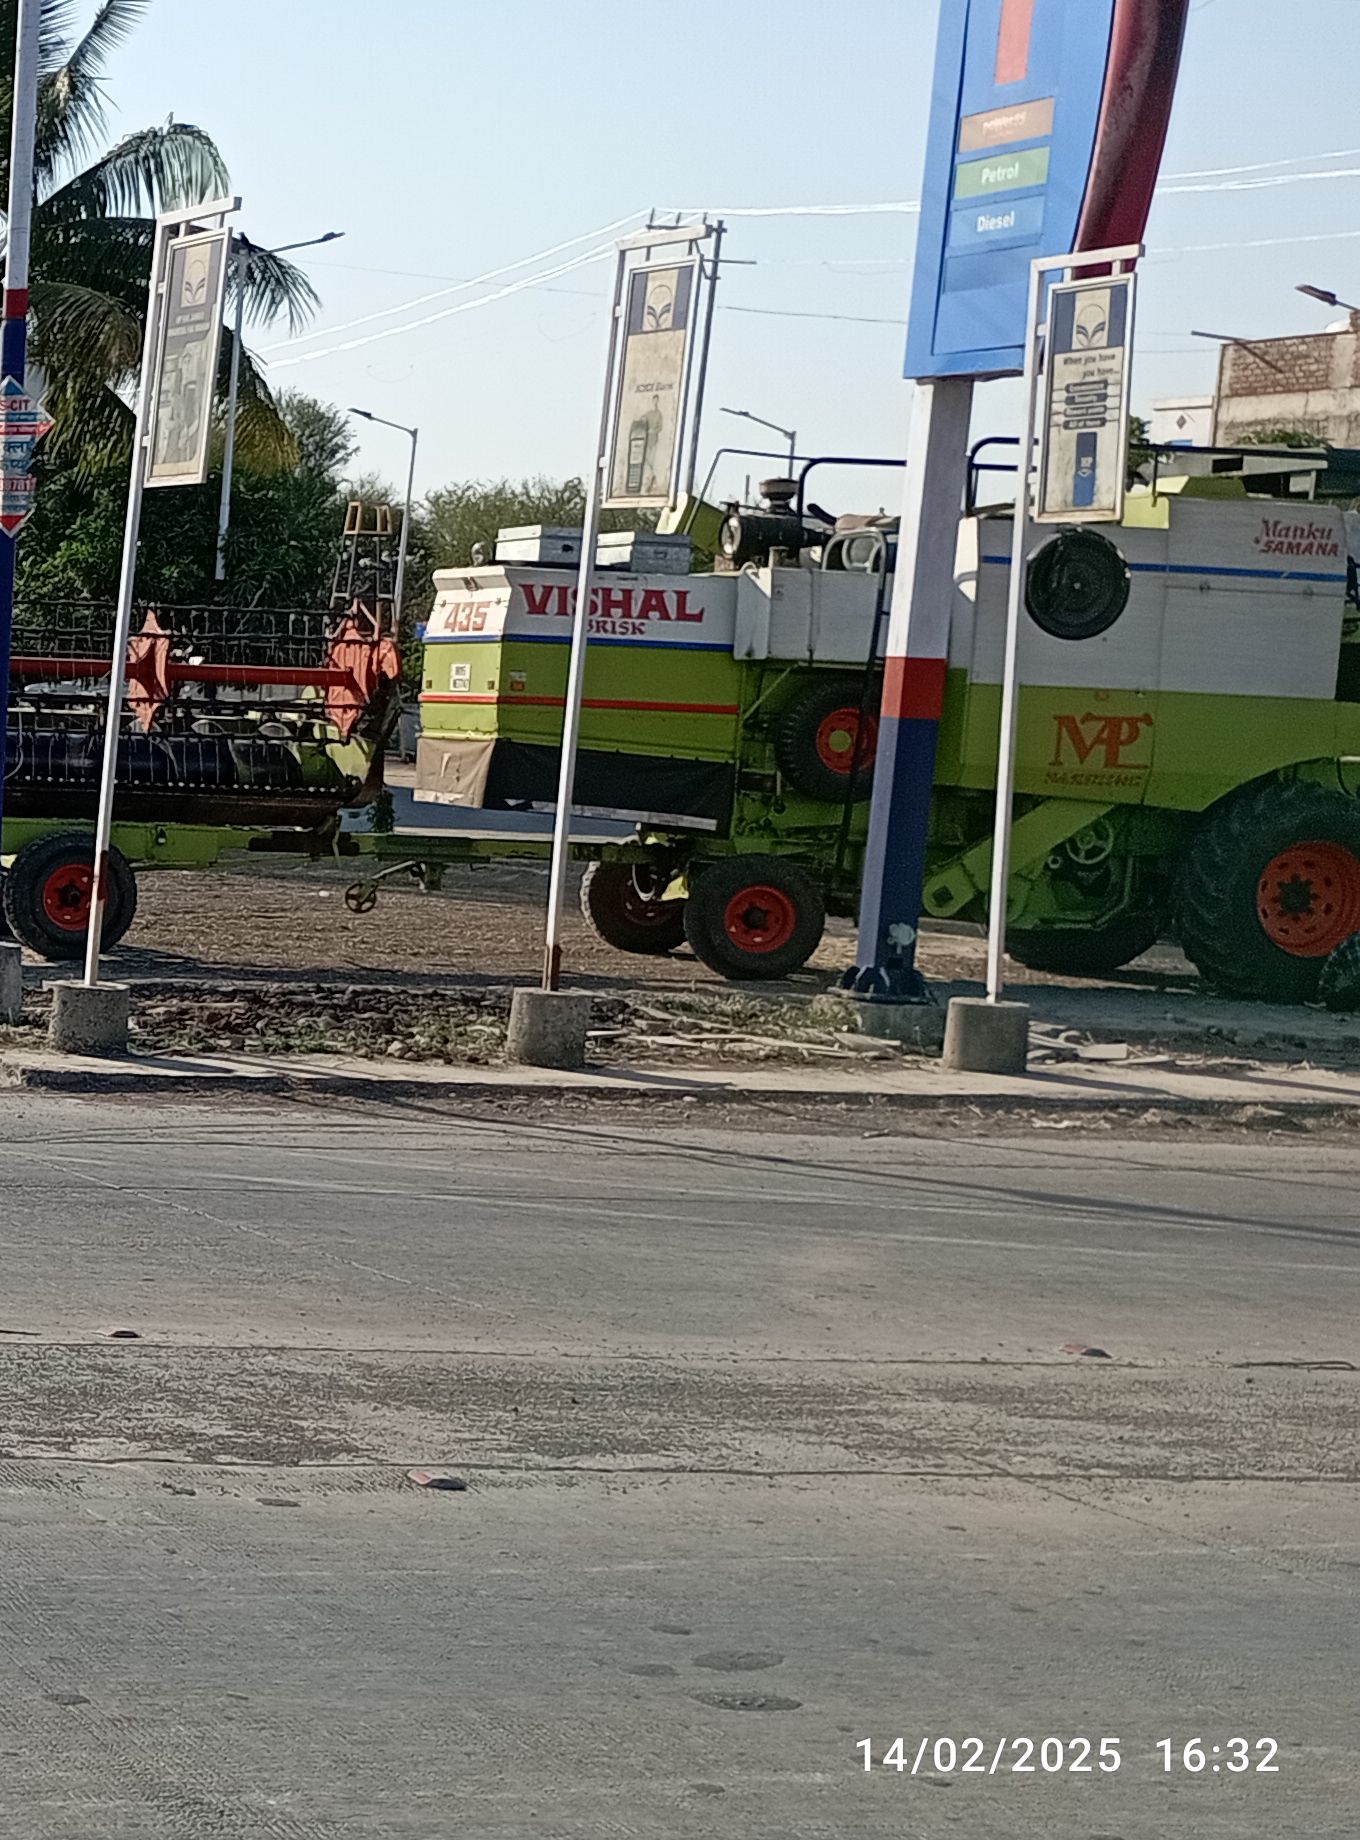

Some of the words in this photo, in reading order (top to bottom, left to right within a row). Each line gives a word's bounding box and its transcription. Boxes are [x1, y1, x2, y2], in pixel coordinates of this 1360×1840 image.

[981, 161, 1020, 185] Petrol
[976, 210, 1015, 232] Diesel
[1084, 357, 1096, 366] you
[1082, 370, 1095, 380] you
[1256, 517, 1333, 543] Manku
[1260, 540, 1339, 557] SAMANA
[443, 601, 492, 632] 435
